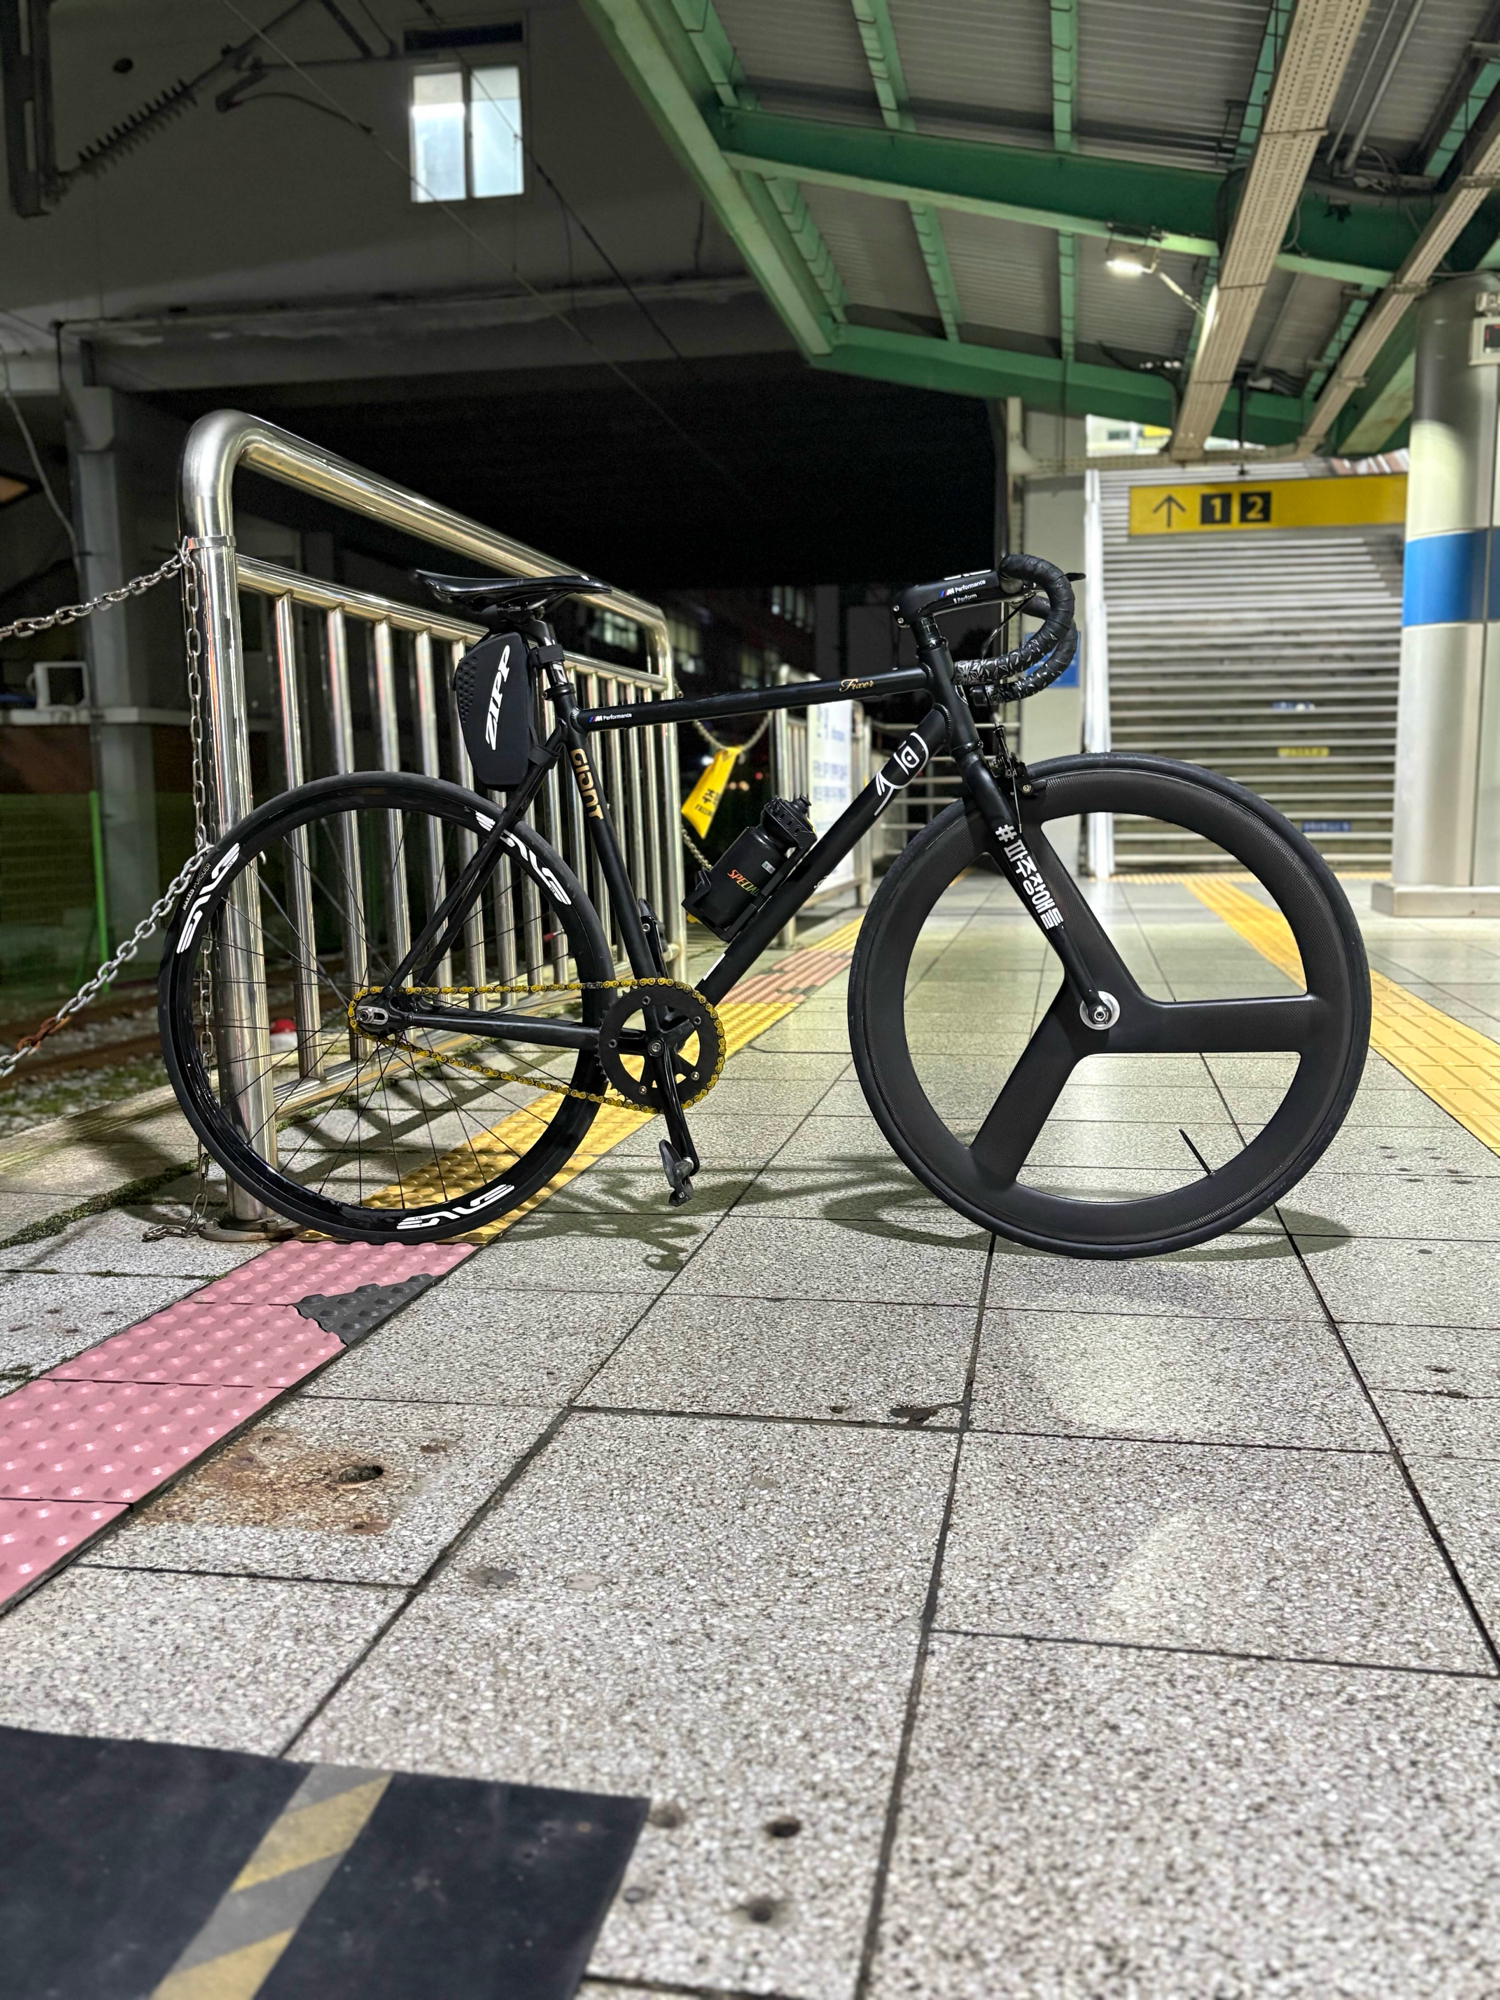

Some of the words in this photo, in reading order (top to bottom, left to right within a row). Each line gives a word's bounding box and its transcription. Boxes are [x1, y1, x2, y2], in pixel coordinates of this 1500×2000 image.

[1210, 497, 1222, 520] 1
[1246, 496, 1264, 519] 2
[954, 580, 986, 593] Performance
[485, 645, 511, 751] ZIPP
[603, 713, 632, 721] Performance
